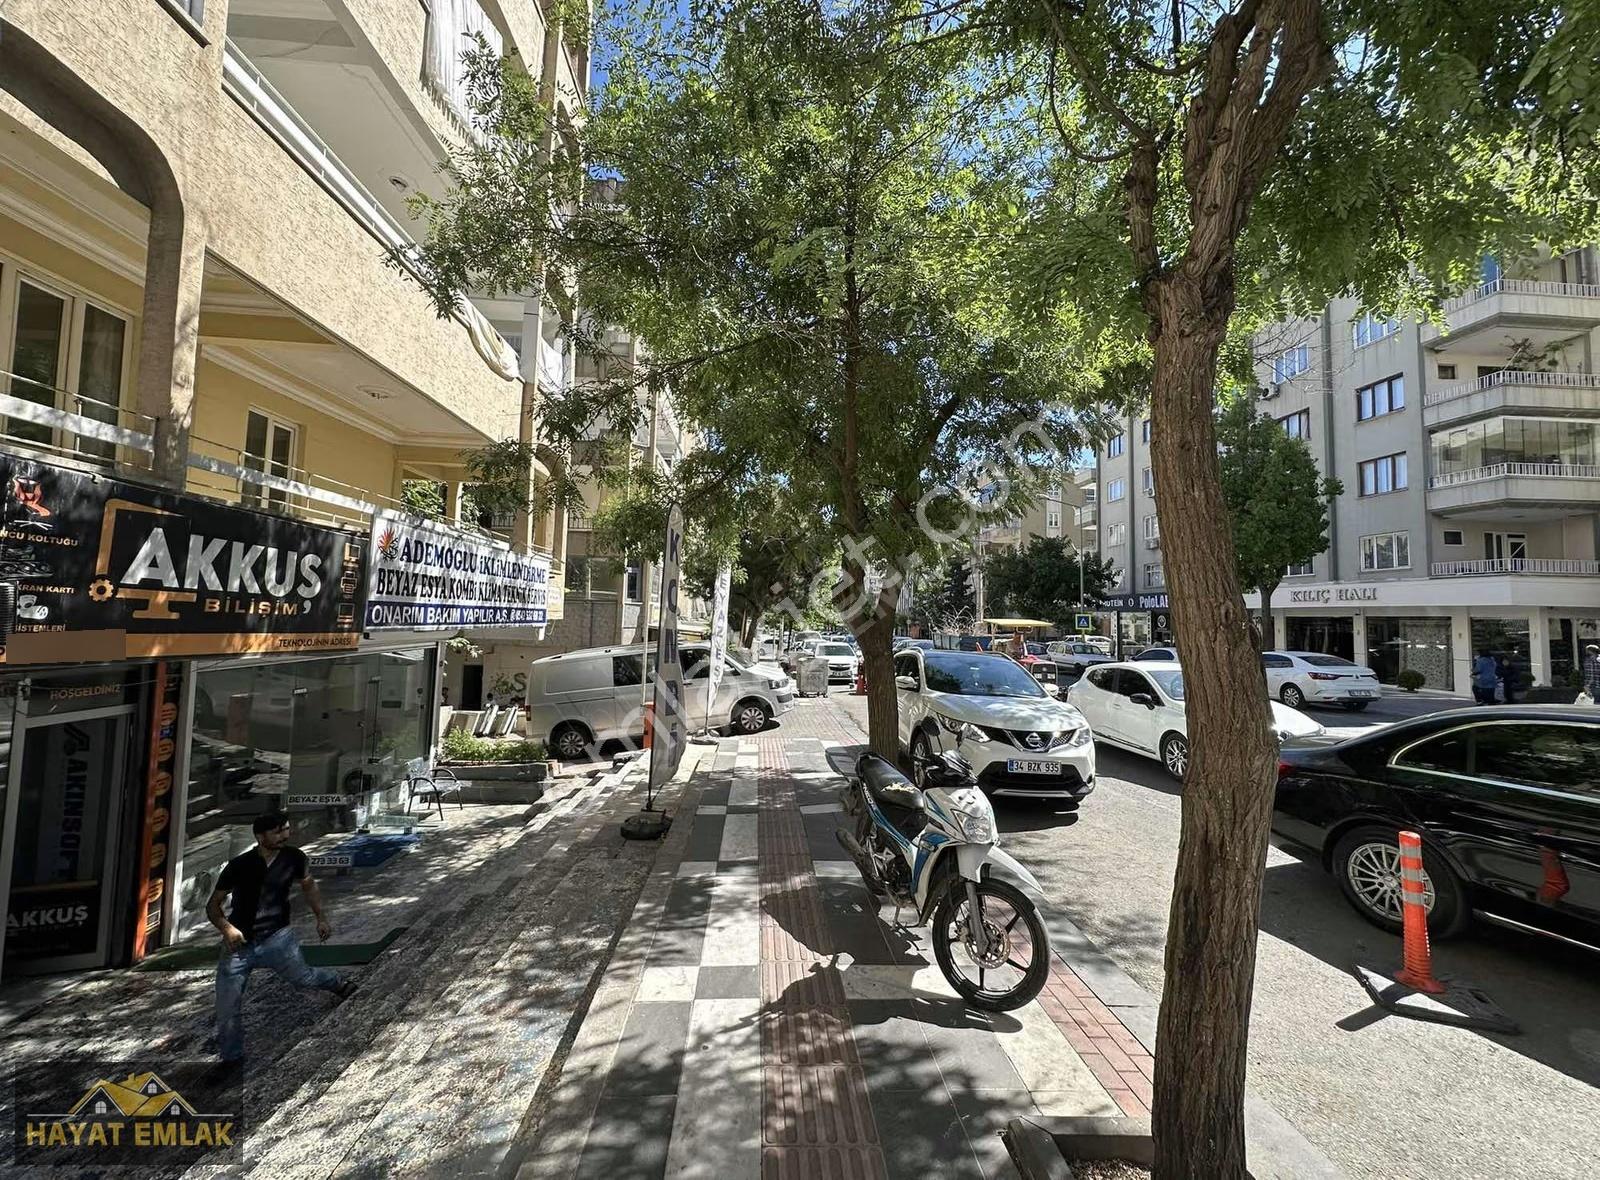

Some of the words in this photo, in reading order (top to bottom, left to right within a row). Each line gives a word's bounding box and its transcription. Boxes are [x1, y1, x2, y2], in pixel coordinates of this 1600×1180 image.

[46, 585, 75, 594] KARTI
[376, 568, 419, 595] BEYAZ
[420, 573, 447, 602] EŞYA
[1335, 588, 1377, 601] HALI
[371, 605, 424, 624] ONARIM
[426, 606, 461, 624] BAKIM
[462, 607, 494, 623] YAPILIR
[1014, 761, 1024, 771] 34
[1027, 762, 1042, 772] BZK
[1045, 763, 1059, 772] 935
[289, 795, 318, 803] BEYAZ
[311, 857, 326, 865] 273
[327, 857, 337, 865] 33
[338, 856, 349, 865] 63
